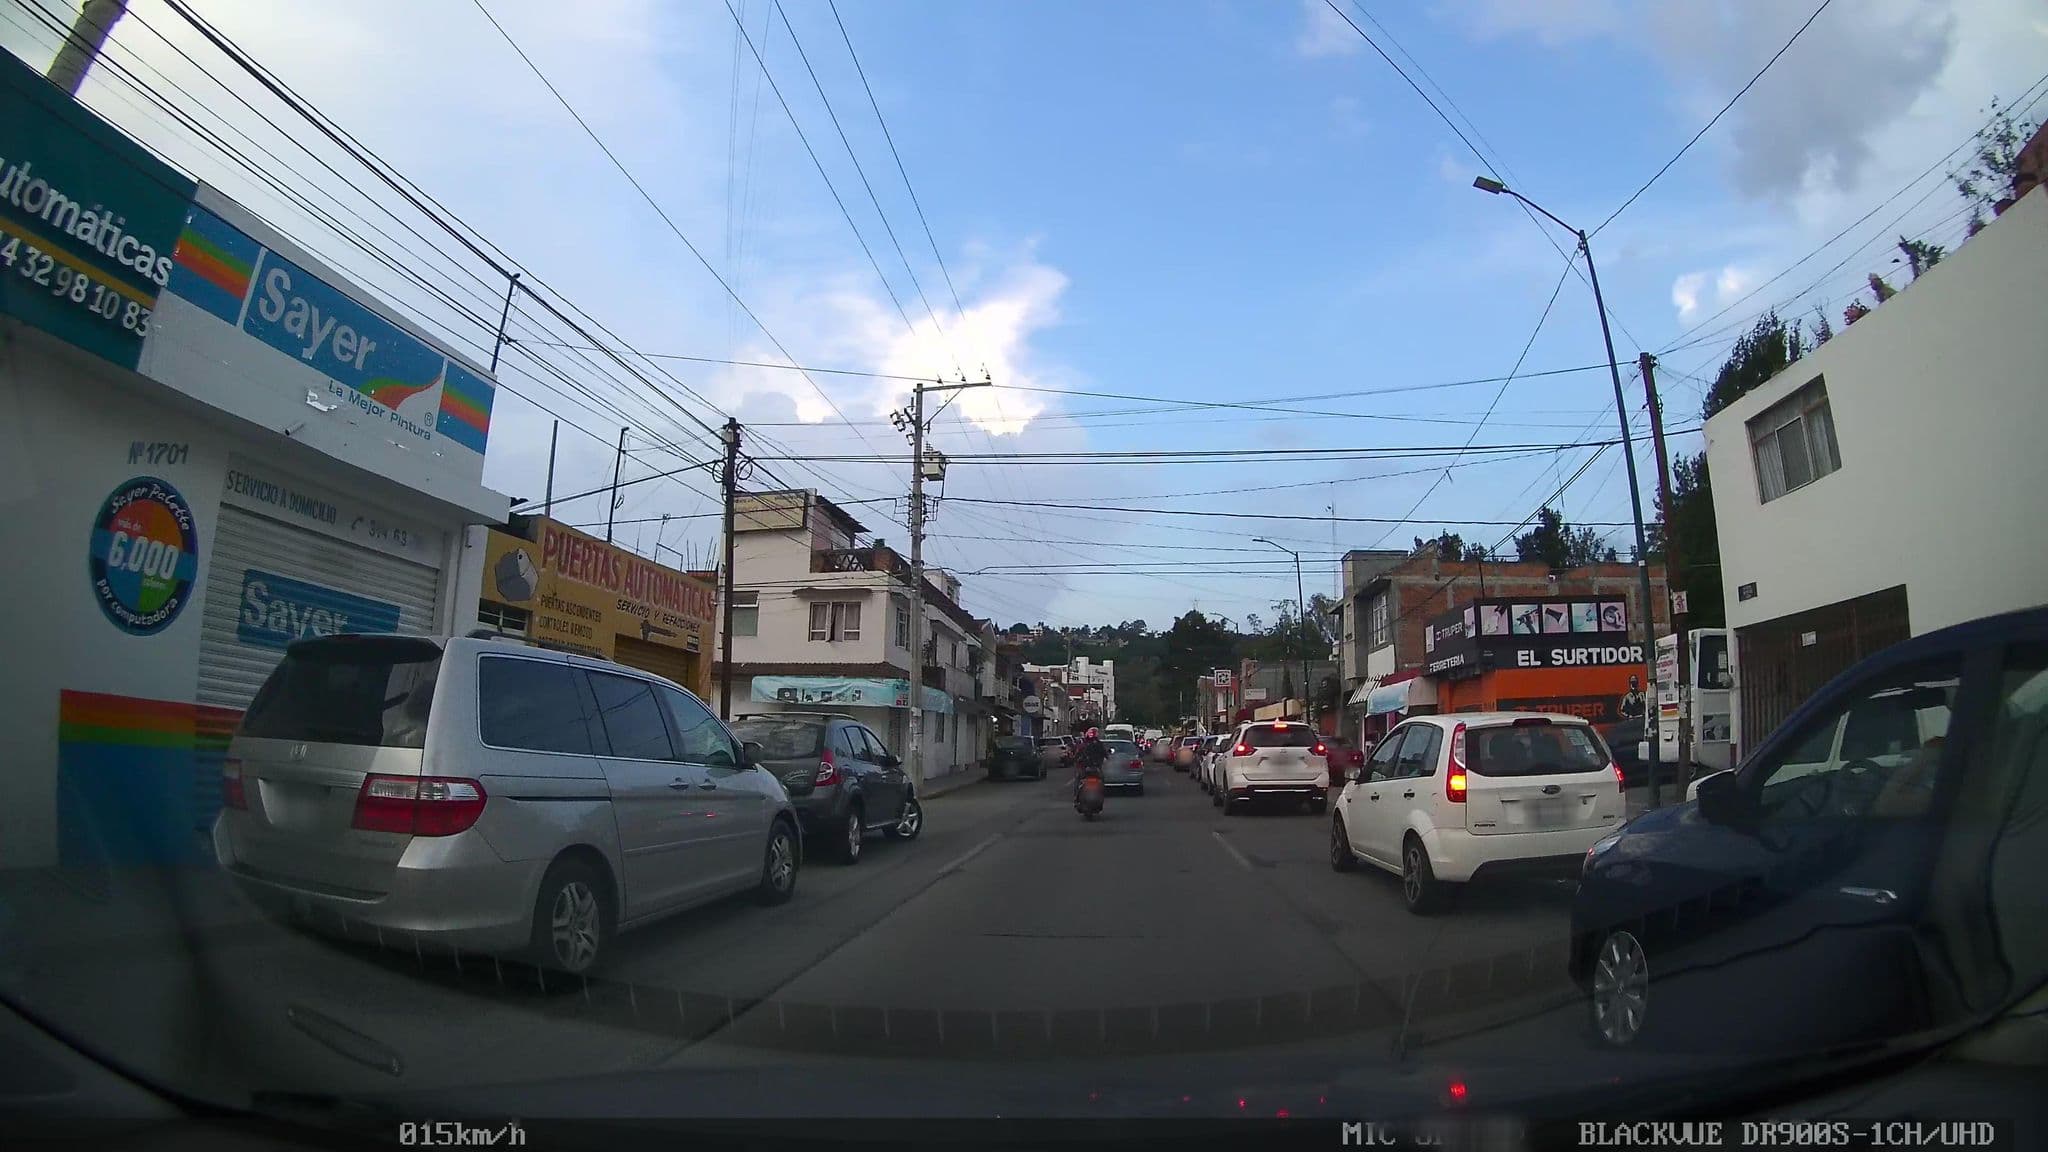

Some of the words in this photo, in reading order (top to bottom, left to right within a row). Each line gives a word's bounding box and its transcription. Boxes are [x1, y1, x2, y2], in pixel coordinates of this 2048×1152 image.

[20, 246, 56, 287] 32
[51, 266, 90, 304] 98
[88, 285, 121, 320] 10
[123, 301, 153, 337] 83
[258, 268, 376, 371] Sayer
[328, 380, 343, 397] La
[348, 391, 386, 418] Mejor
[390, 412, 432, 440] Pintura
[112, 486, 147, 514] Sayer
[226, 470, 278, 504] SERVICIO
[279, 488, 287, 508] A
[289, 493, 337, 525] DOMICILIO
[541, 526, 622, 592] PUERTAS
[623, 559, 715, 622] AUTOMATICAS
[112, 597, 178, 626] computadora
[243, 580, 349, 640] Sayer
[540, 594, 565, 612] PUERTAS
[616, 599, 650, 618] SERVICIO
[654, 610, 660, 620] Y
[1517, 650, 1541, 666] EL
[1551, 646, 1643, 666] SURTIDOR
